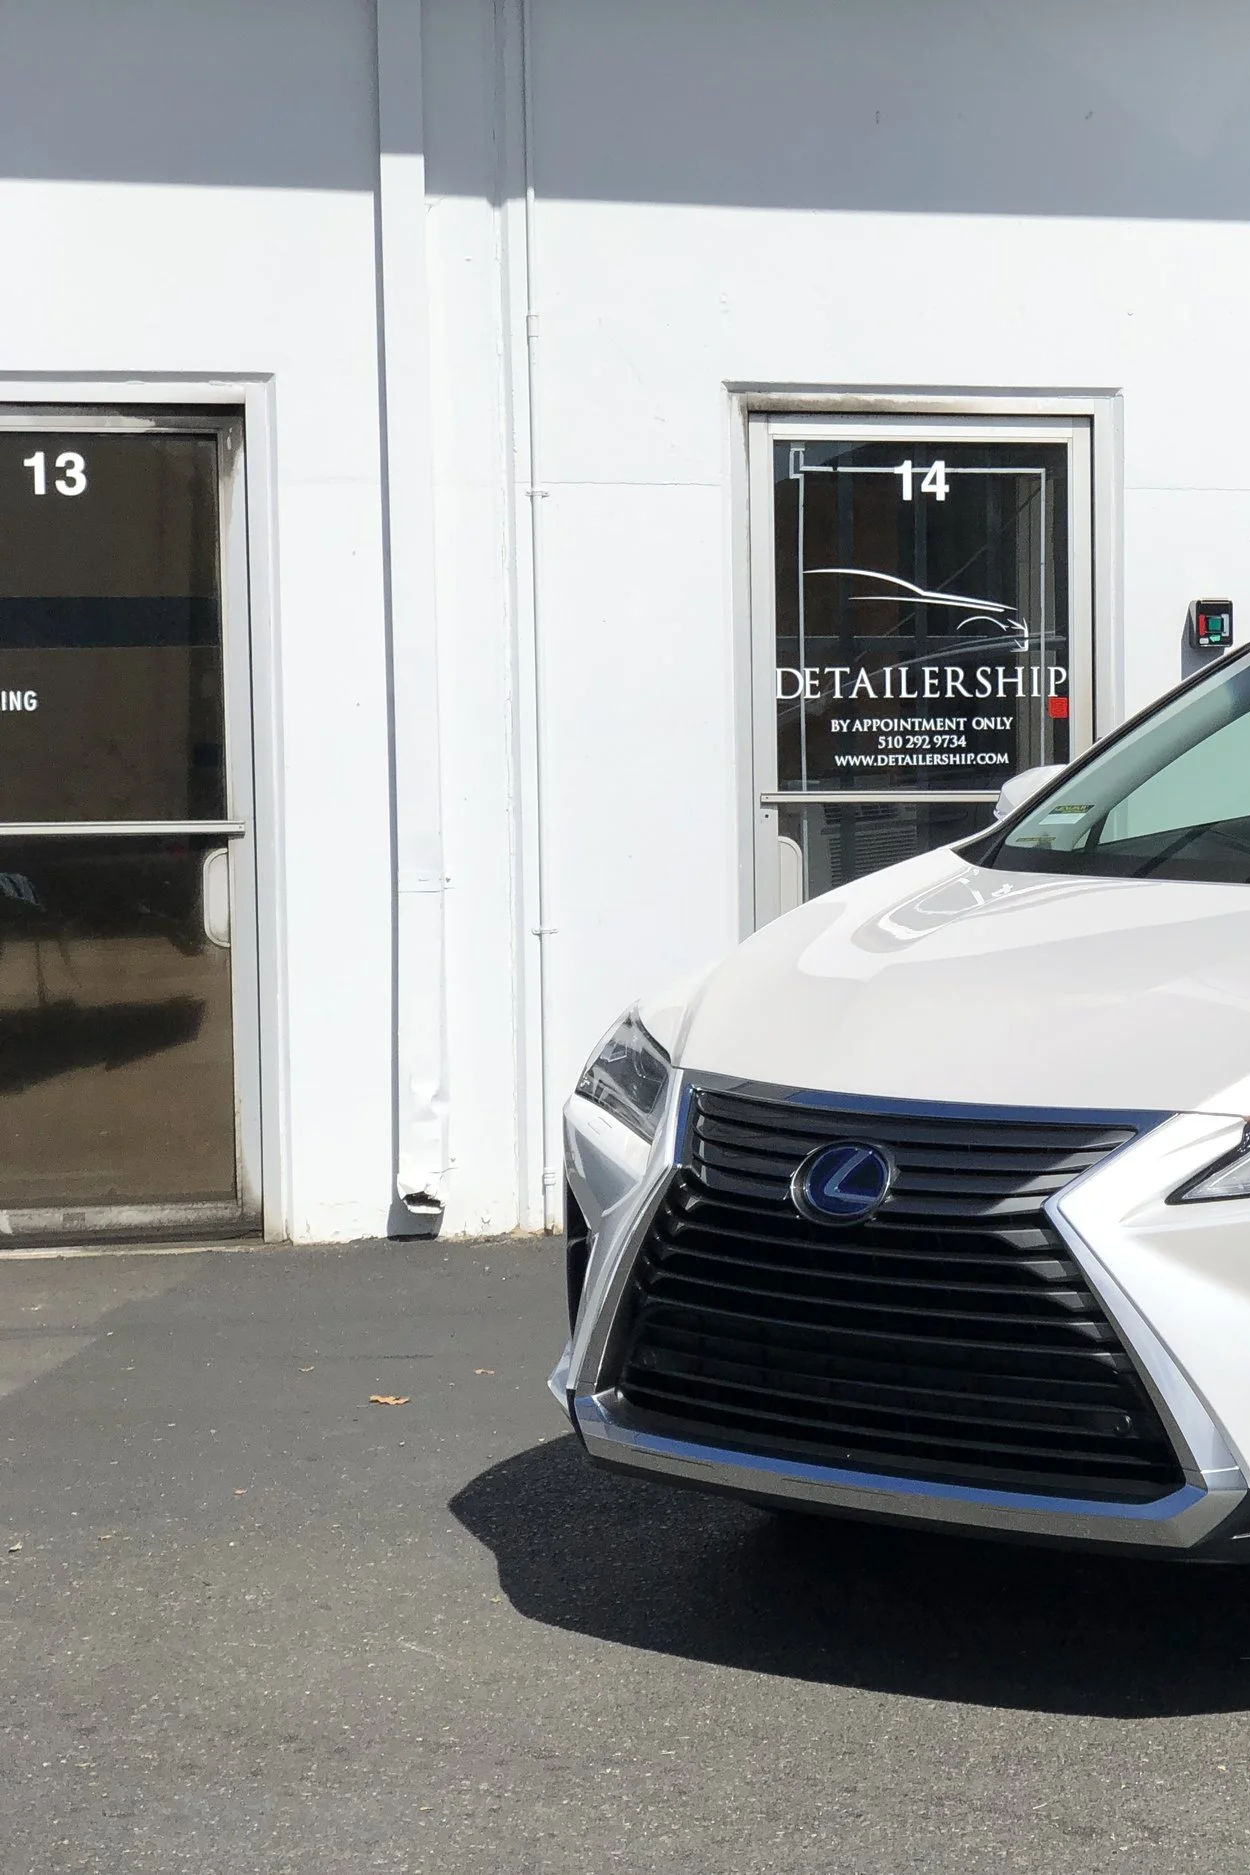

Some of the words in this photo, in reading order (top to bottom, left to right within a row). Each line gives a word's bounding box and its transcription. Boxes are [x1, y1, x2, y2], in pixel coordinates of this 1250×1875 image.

[23, 451, 87, 496] 13
[894, 460, 950, 501] 14
[776, 666, 1067, 699] DETAILERSHIP
[1, 690, 37, 711] ING
[830, 719, 851, 732] BY
[853, 718, 967, 732] APPOINTMENT
[972, 717, 1013, 730] ONLY
[878, 736, 903, 749] 510
[905, 735, 931, 748] 292
[933, 735, 966, 748] 9734
[835, 753, 1009, 767] WWW.DETAILERSHIP.COM
